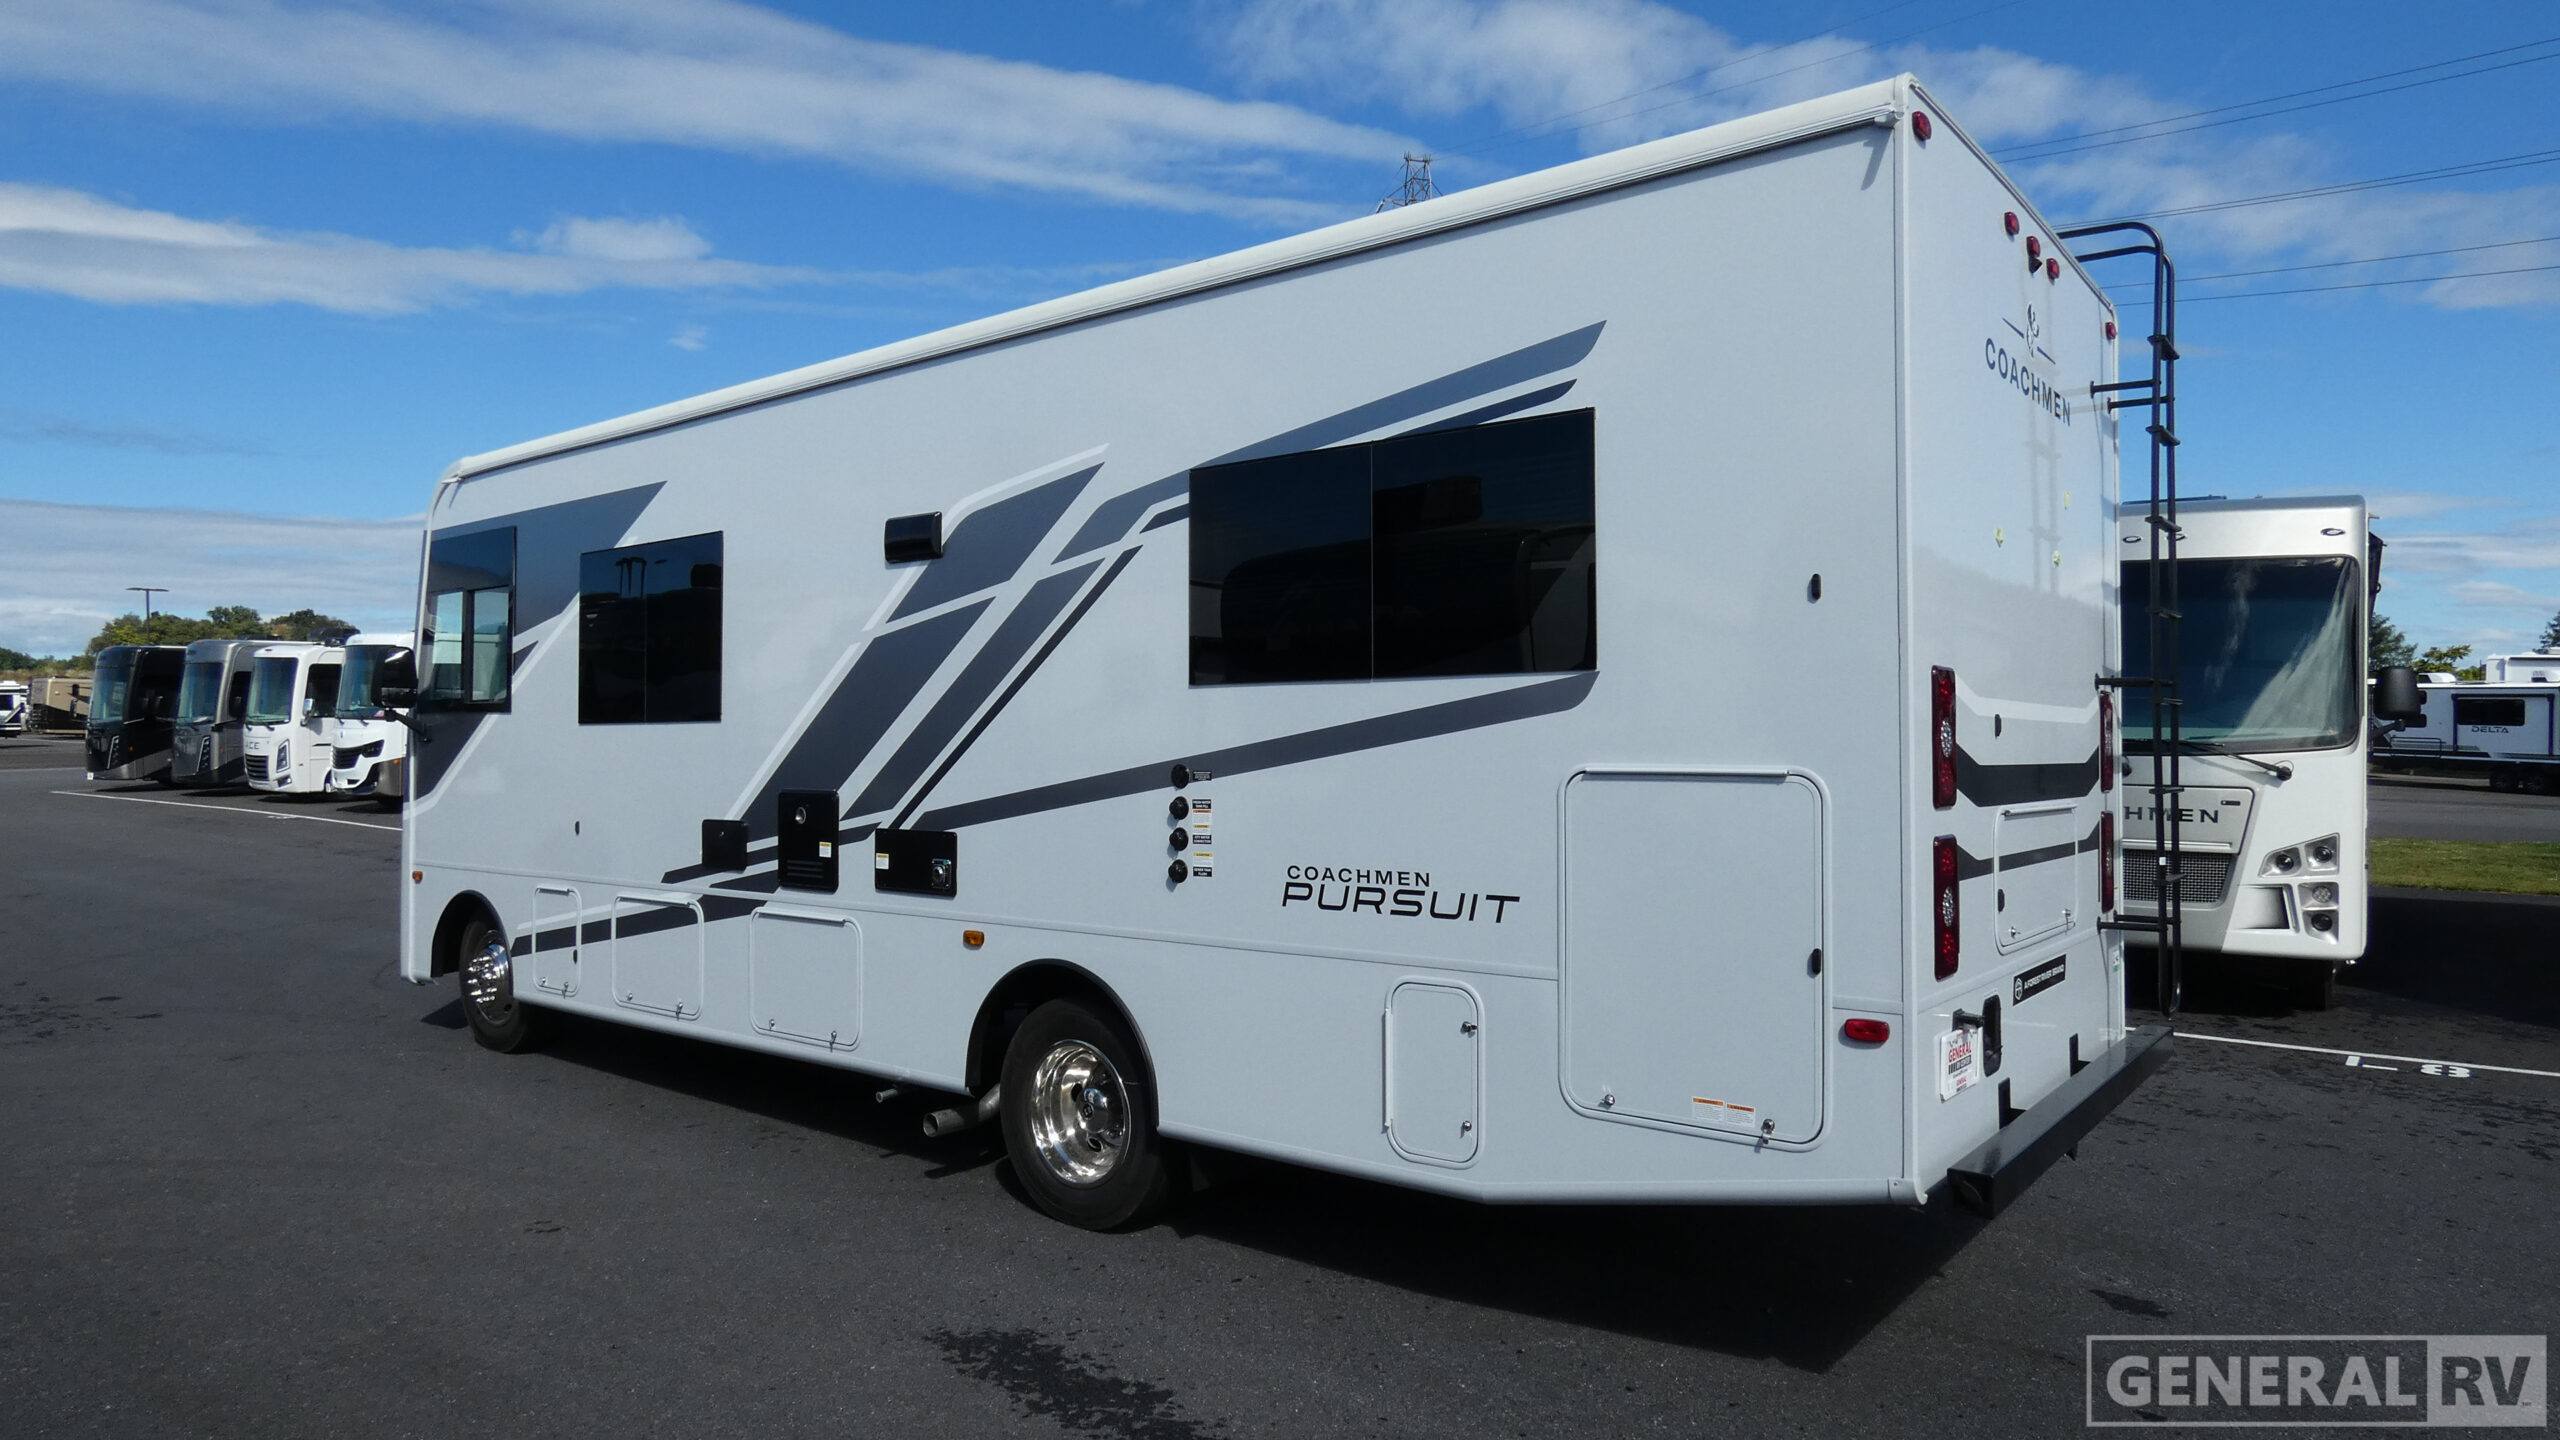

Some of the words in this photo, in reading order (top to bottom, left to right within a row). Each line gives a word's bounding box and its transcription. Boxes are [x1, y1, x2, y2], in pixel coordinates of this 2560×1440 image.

[1985, 337, 2070, 427] COACHMEN
[2471, 725, 2509, 734] DELTA
[1287, 865, 1430, 887] COACHMEN
[1282, 881, 1521, 924] PURSUIT
